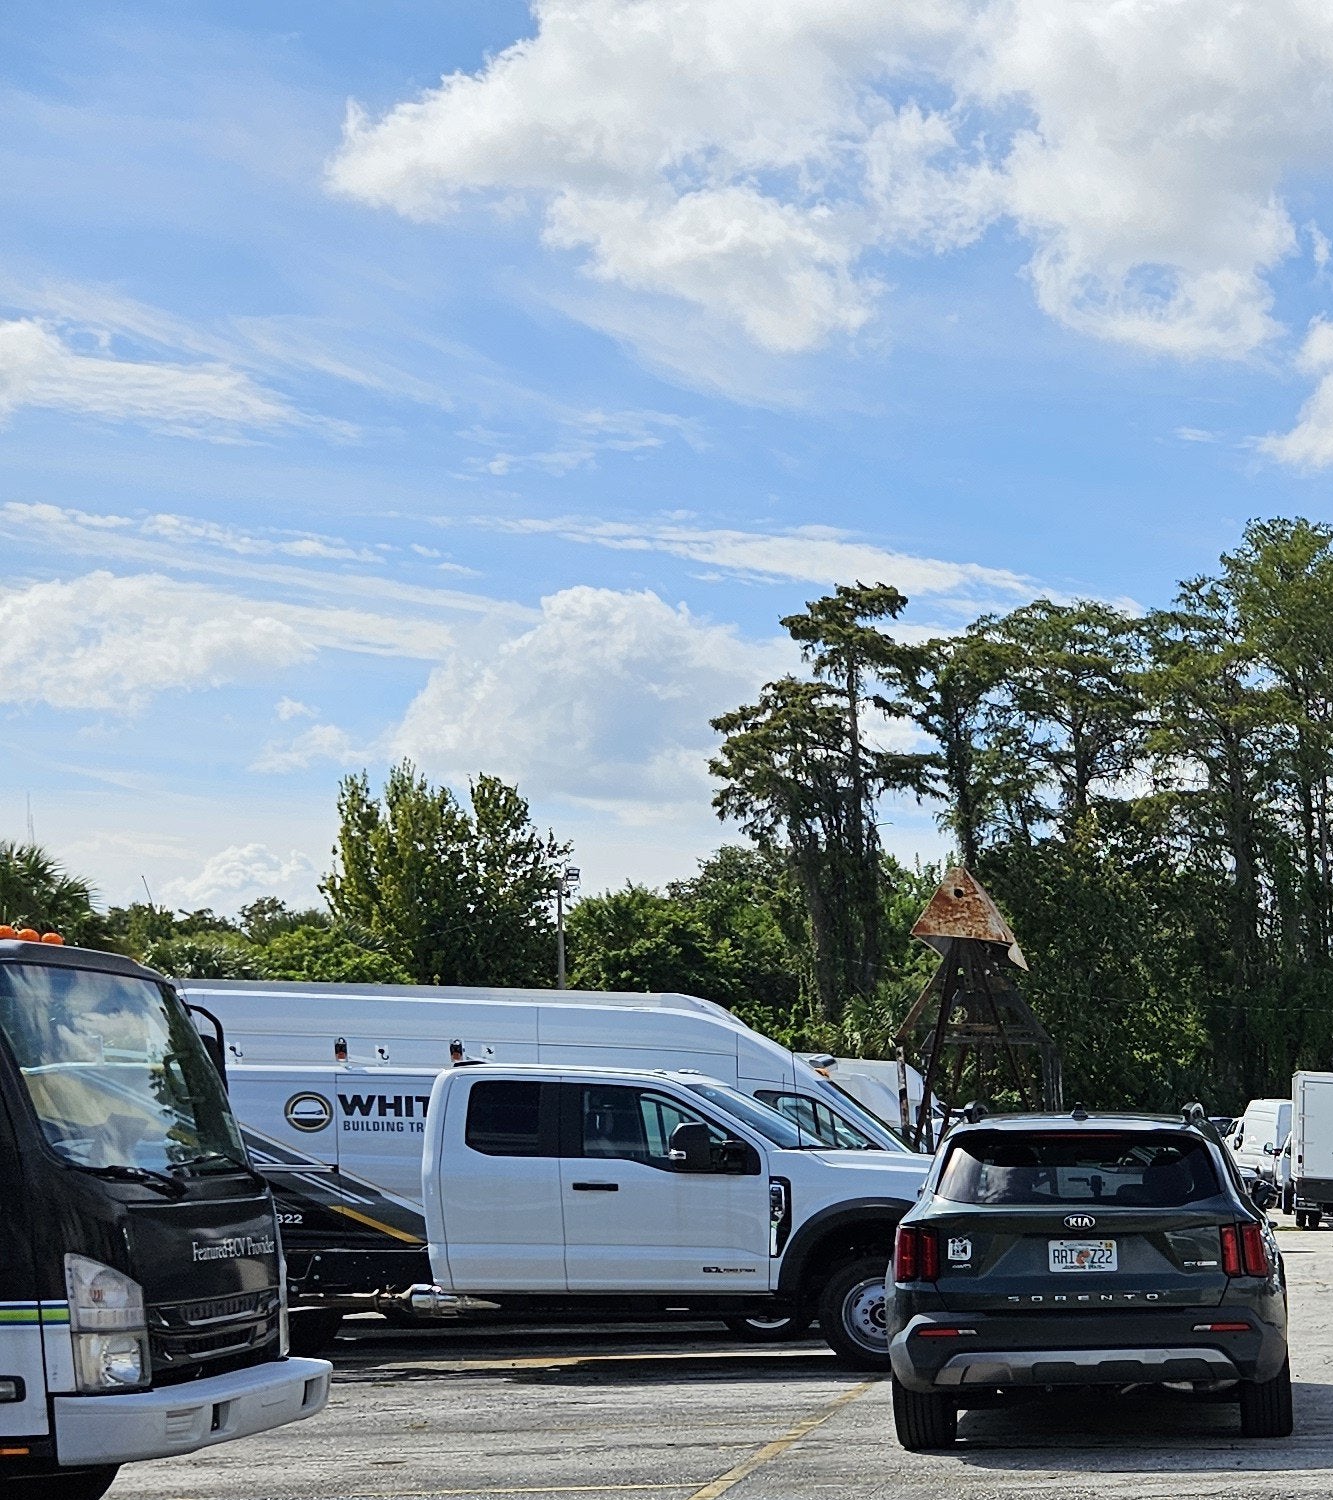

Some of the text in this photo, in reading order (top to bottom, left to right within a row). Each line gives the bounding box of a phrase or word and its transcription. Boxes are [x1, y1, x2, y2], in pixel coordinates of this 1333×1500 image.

[343, 1120, 404, 1132] BUILDING
[1069, 1217, 1091, 1228] KIA
[1089, 1248, 1113, 1264] Z22
